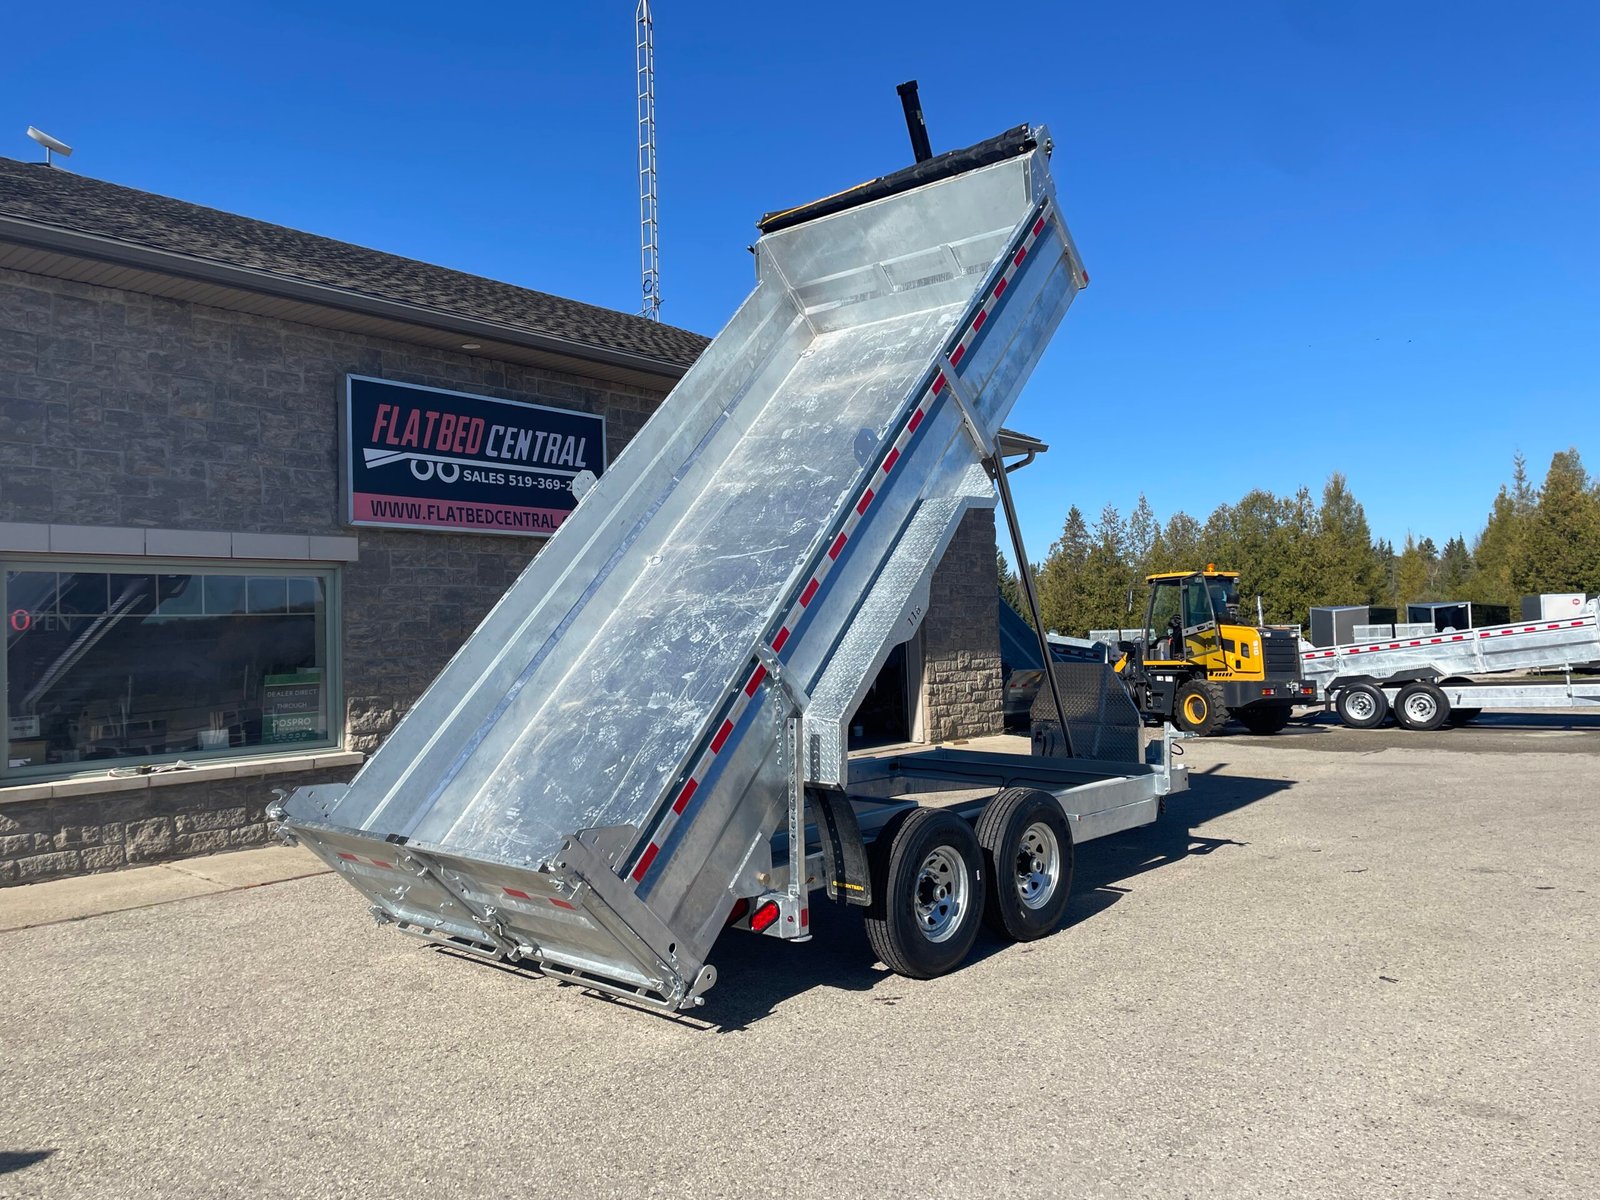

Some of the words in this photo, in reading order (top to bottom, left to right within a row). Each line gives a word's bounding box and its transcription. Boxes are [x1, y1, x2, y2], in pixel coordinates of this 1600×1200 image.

[372, 403, 485, 455] FLATBED
[485, 424, 587, 468] CENTRAL
[463, 470, 505, 485] SALES
[370, 500, 568, 529] WWW.FLATBEDCENTRAL
[11, 609, 71, 631] OPEN
[267, 690, 293, 698] DEALER
